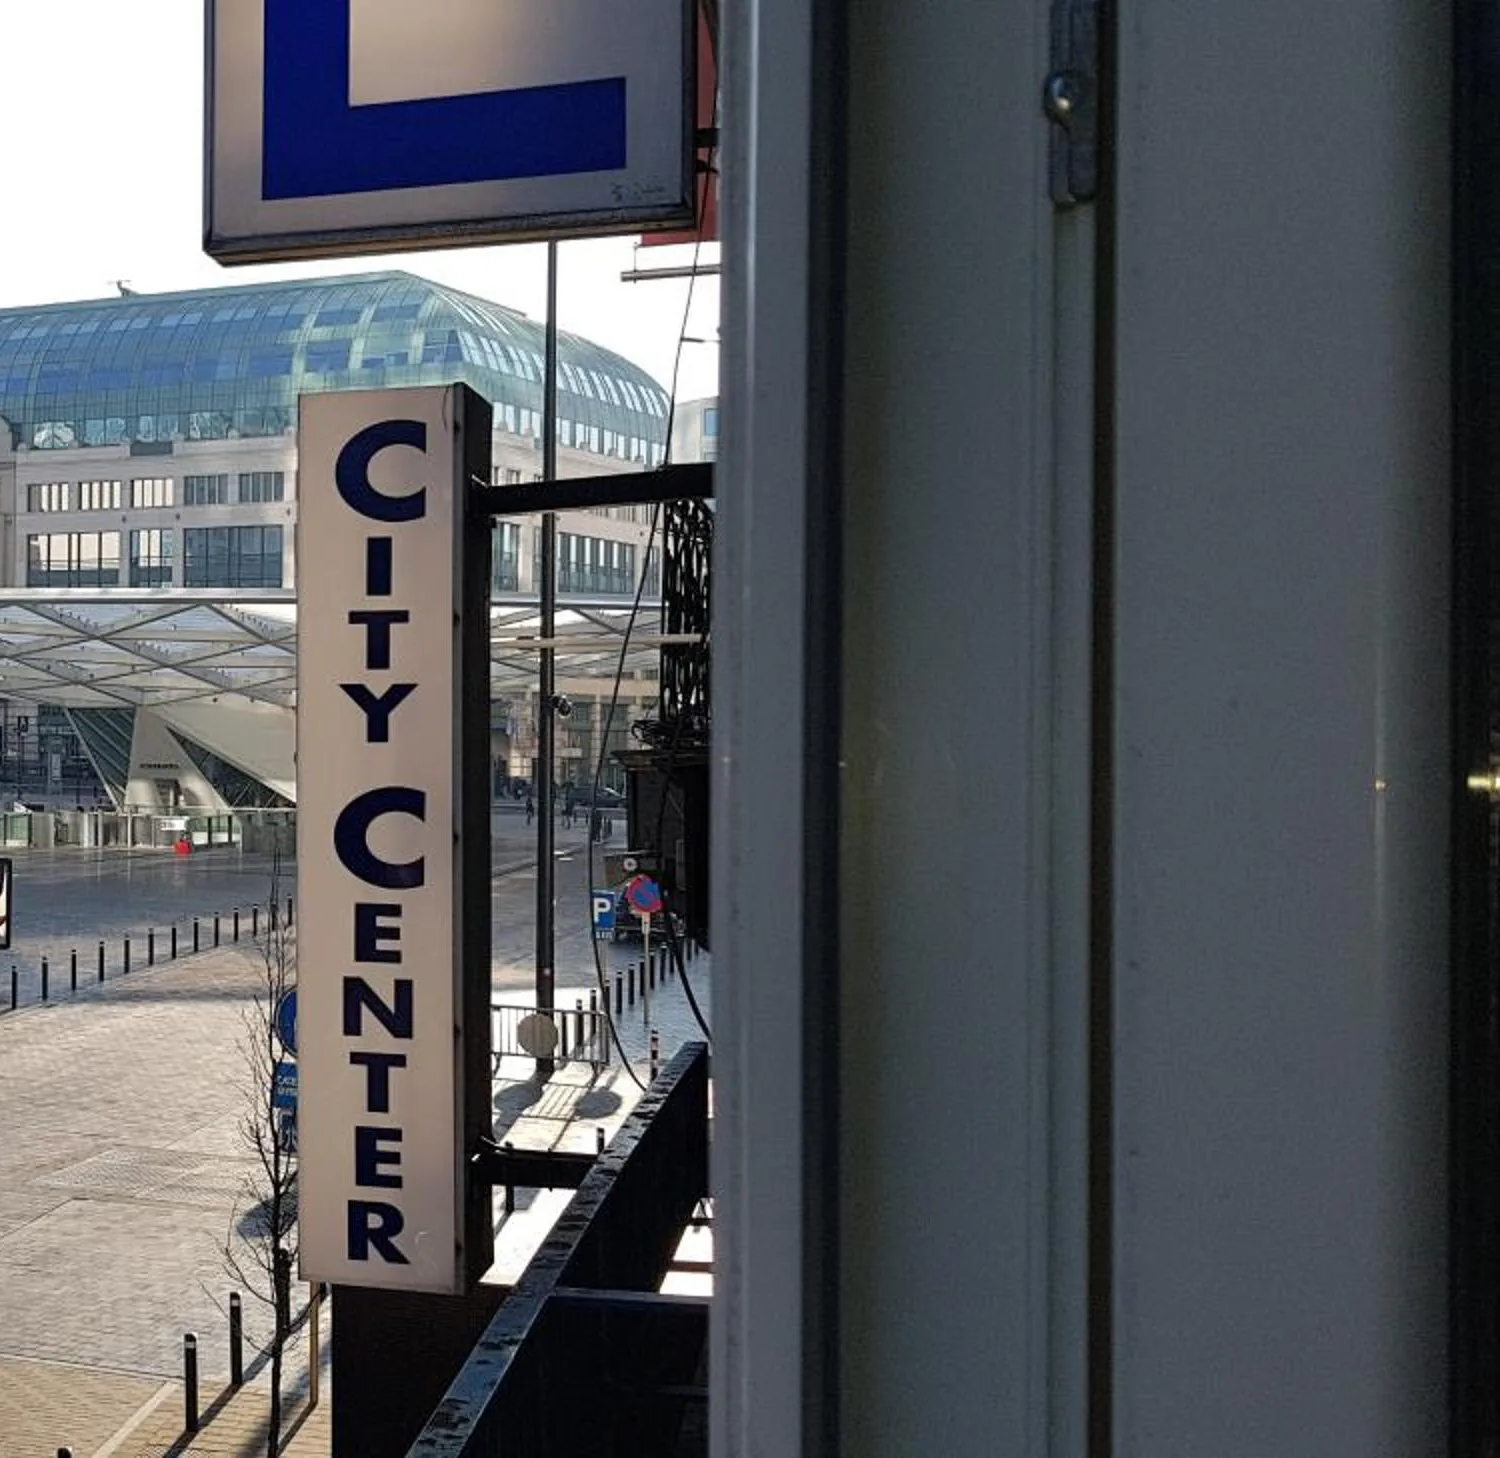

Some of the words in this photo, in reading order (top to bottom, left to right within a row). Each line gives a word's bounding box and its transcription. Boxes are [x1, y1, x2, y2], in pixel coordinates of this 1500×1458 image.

[335, 419, 427, 743] CITY
[333, 786, 427, 1266] CENTER
[593, 897, 612, 924] P
